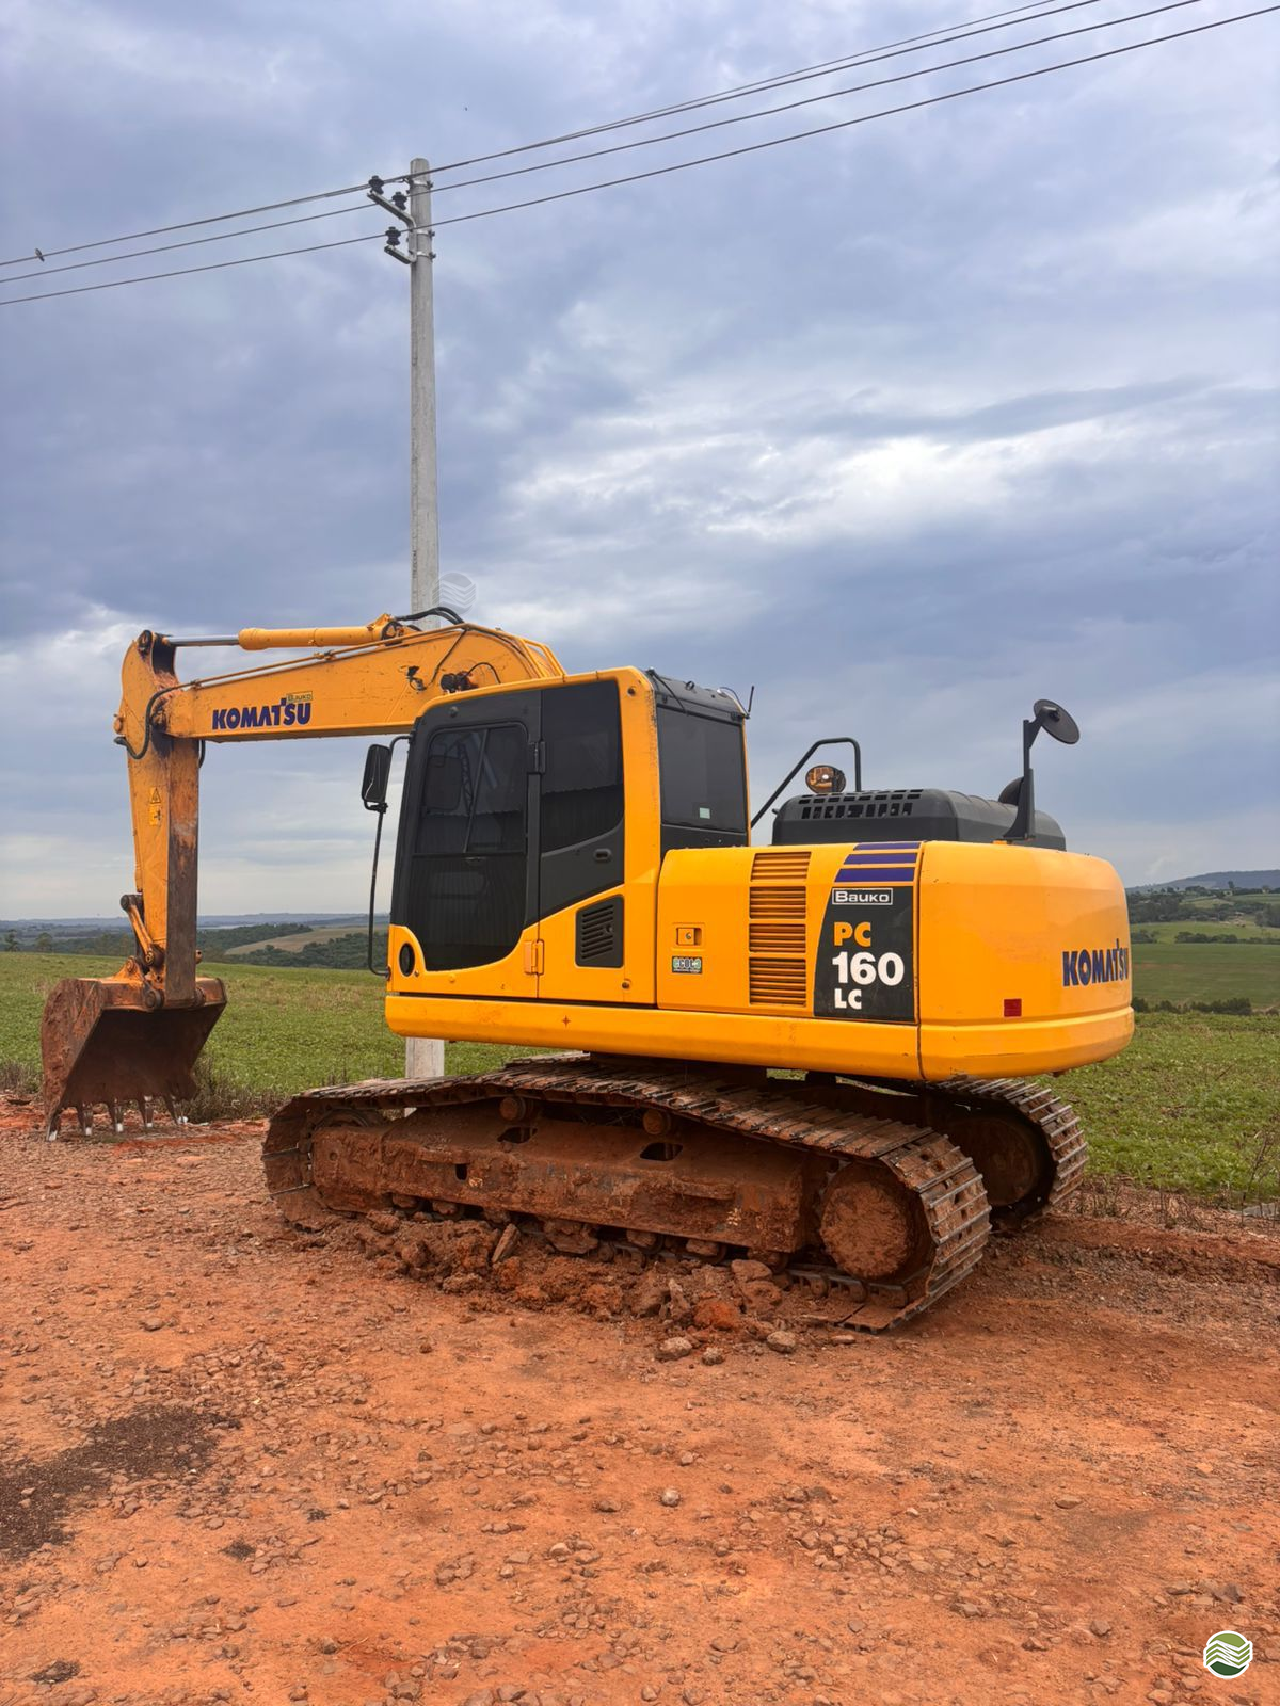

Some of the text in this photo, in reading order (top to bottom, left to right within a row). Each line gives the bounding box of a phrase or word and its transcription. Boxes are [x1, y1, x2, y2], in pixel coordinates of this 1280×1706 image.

[211, 698, 311, 730] KOMATSU
[833, 921, 871, 948] PC
[832, 951, 905, 986] 160
[1061, 938, 1130, 987] KOMATSU
[834, 987, 863, 1010] LC
